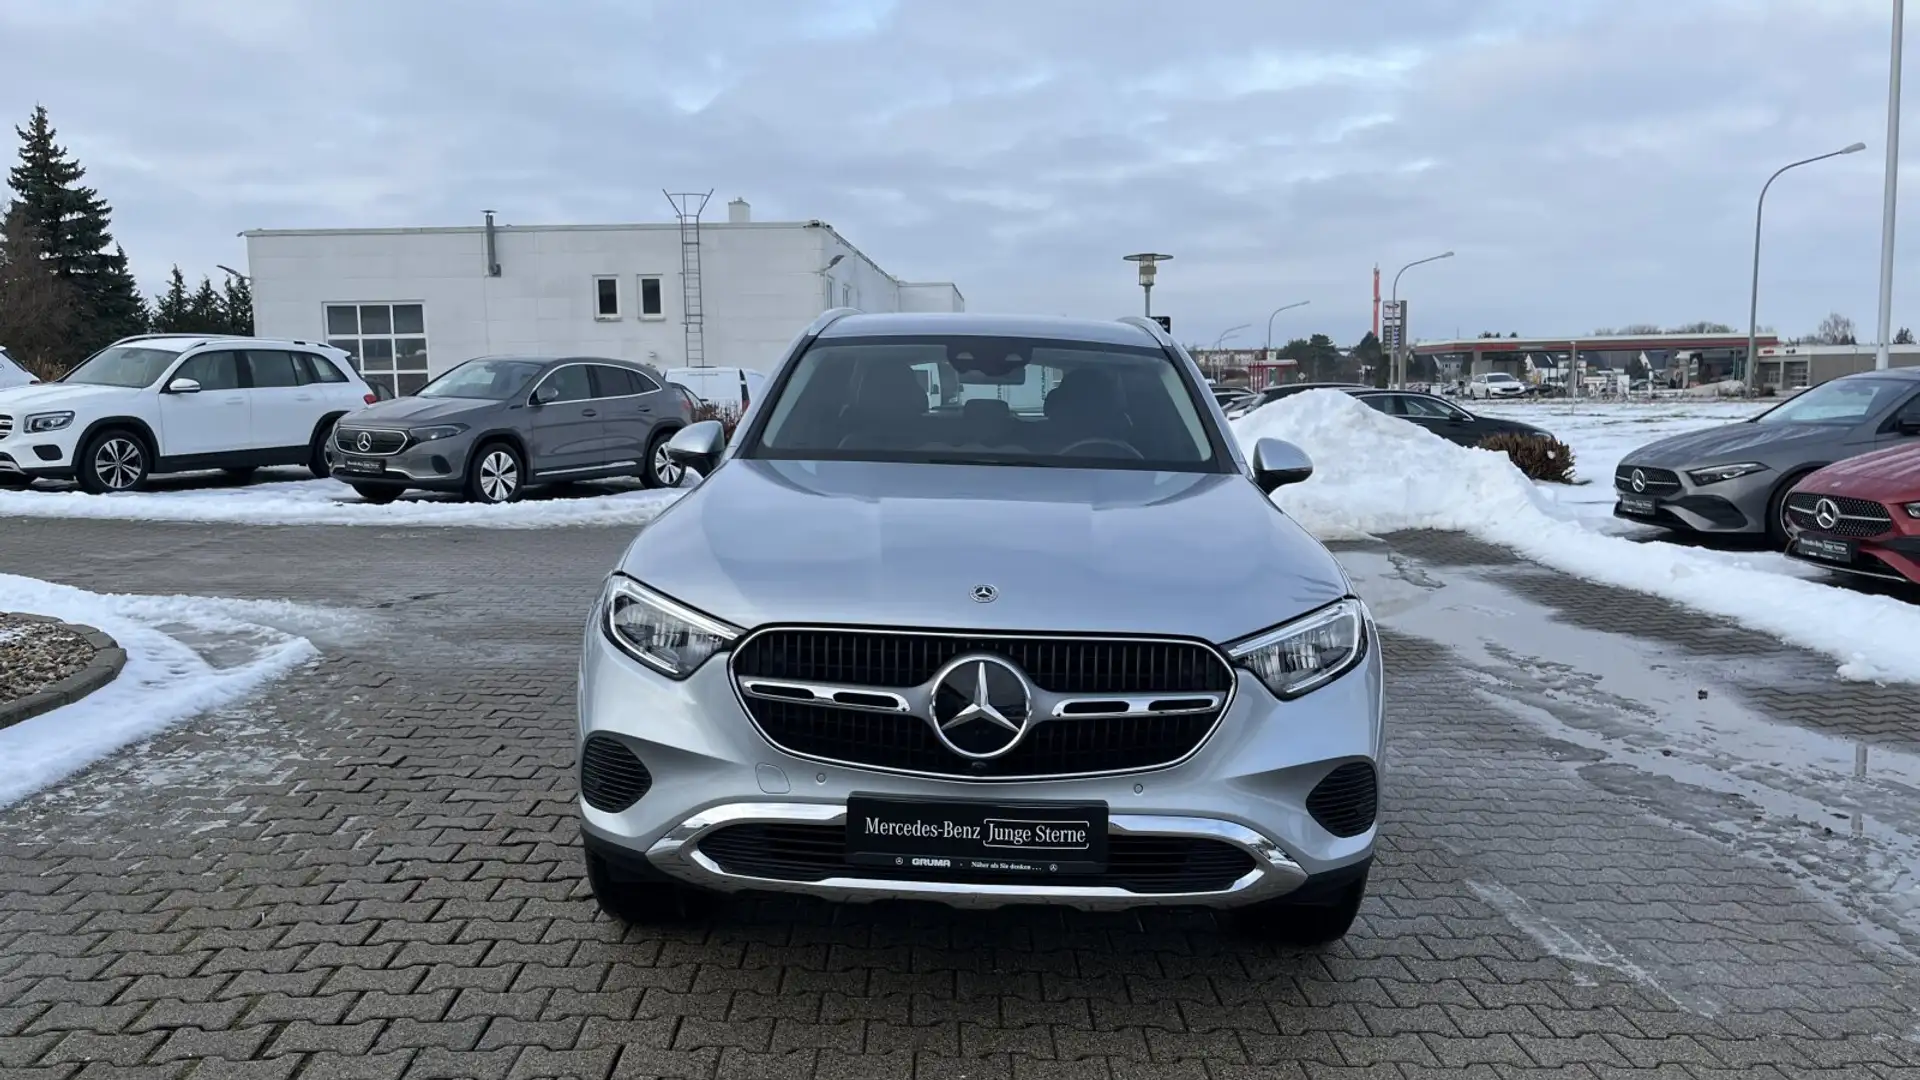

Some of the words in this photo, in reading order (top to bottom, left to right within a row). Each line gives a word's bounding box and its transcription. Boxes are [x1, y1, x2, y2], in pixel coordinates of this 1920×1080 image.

[864, 816, 981, 840] Mercedes-Benz
[987, 823, 1032, 845] Junge
[1035, 824, 1087, 843] Sterne
[912, 858, 951, 868] GRUMA
